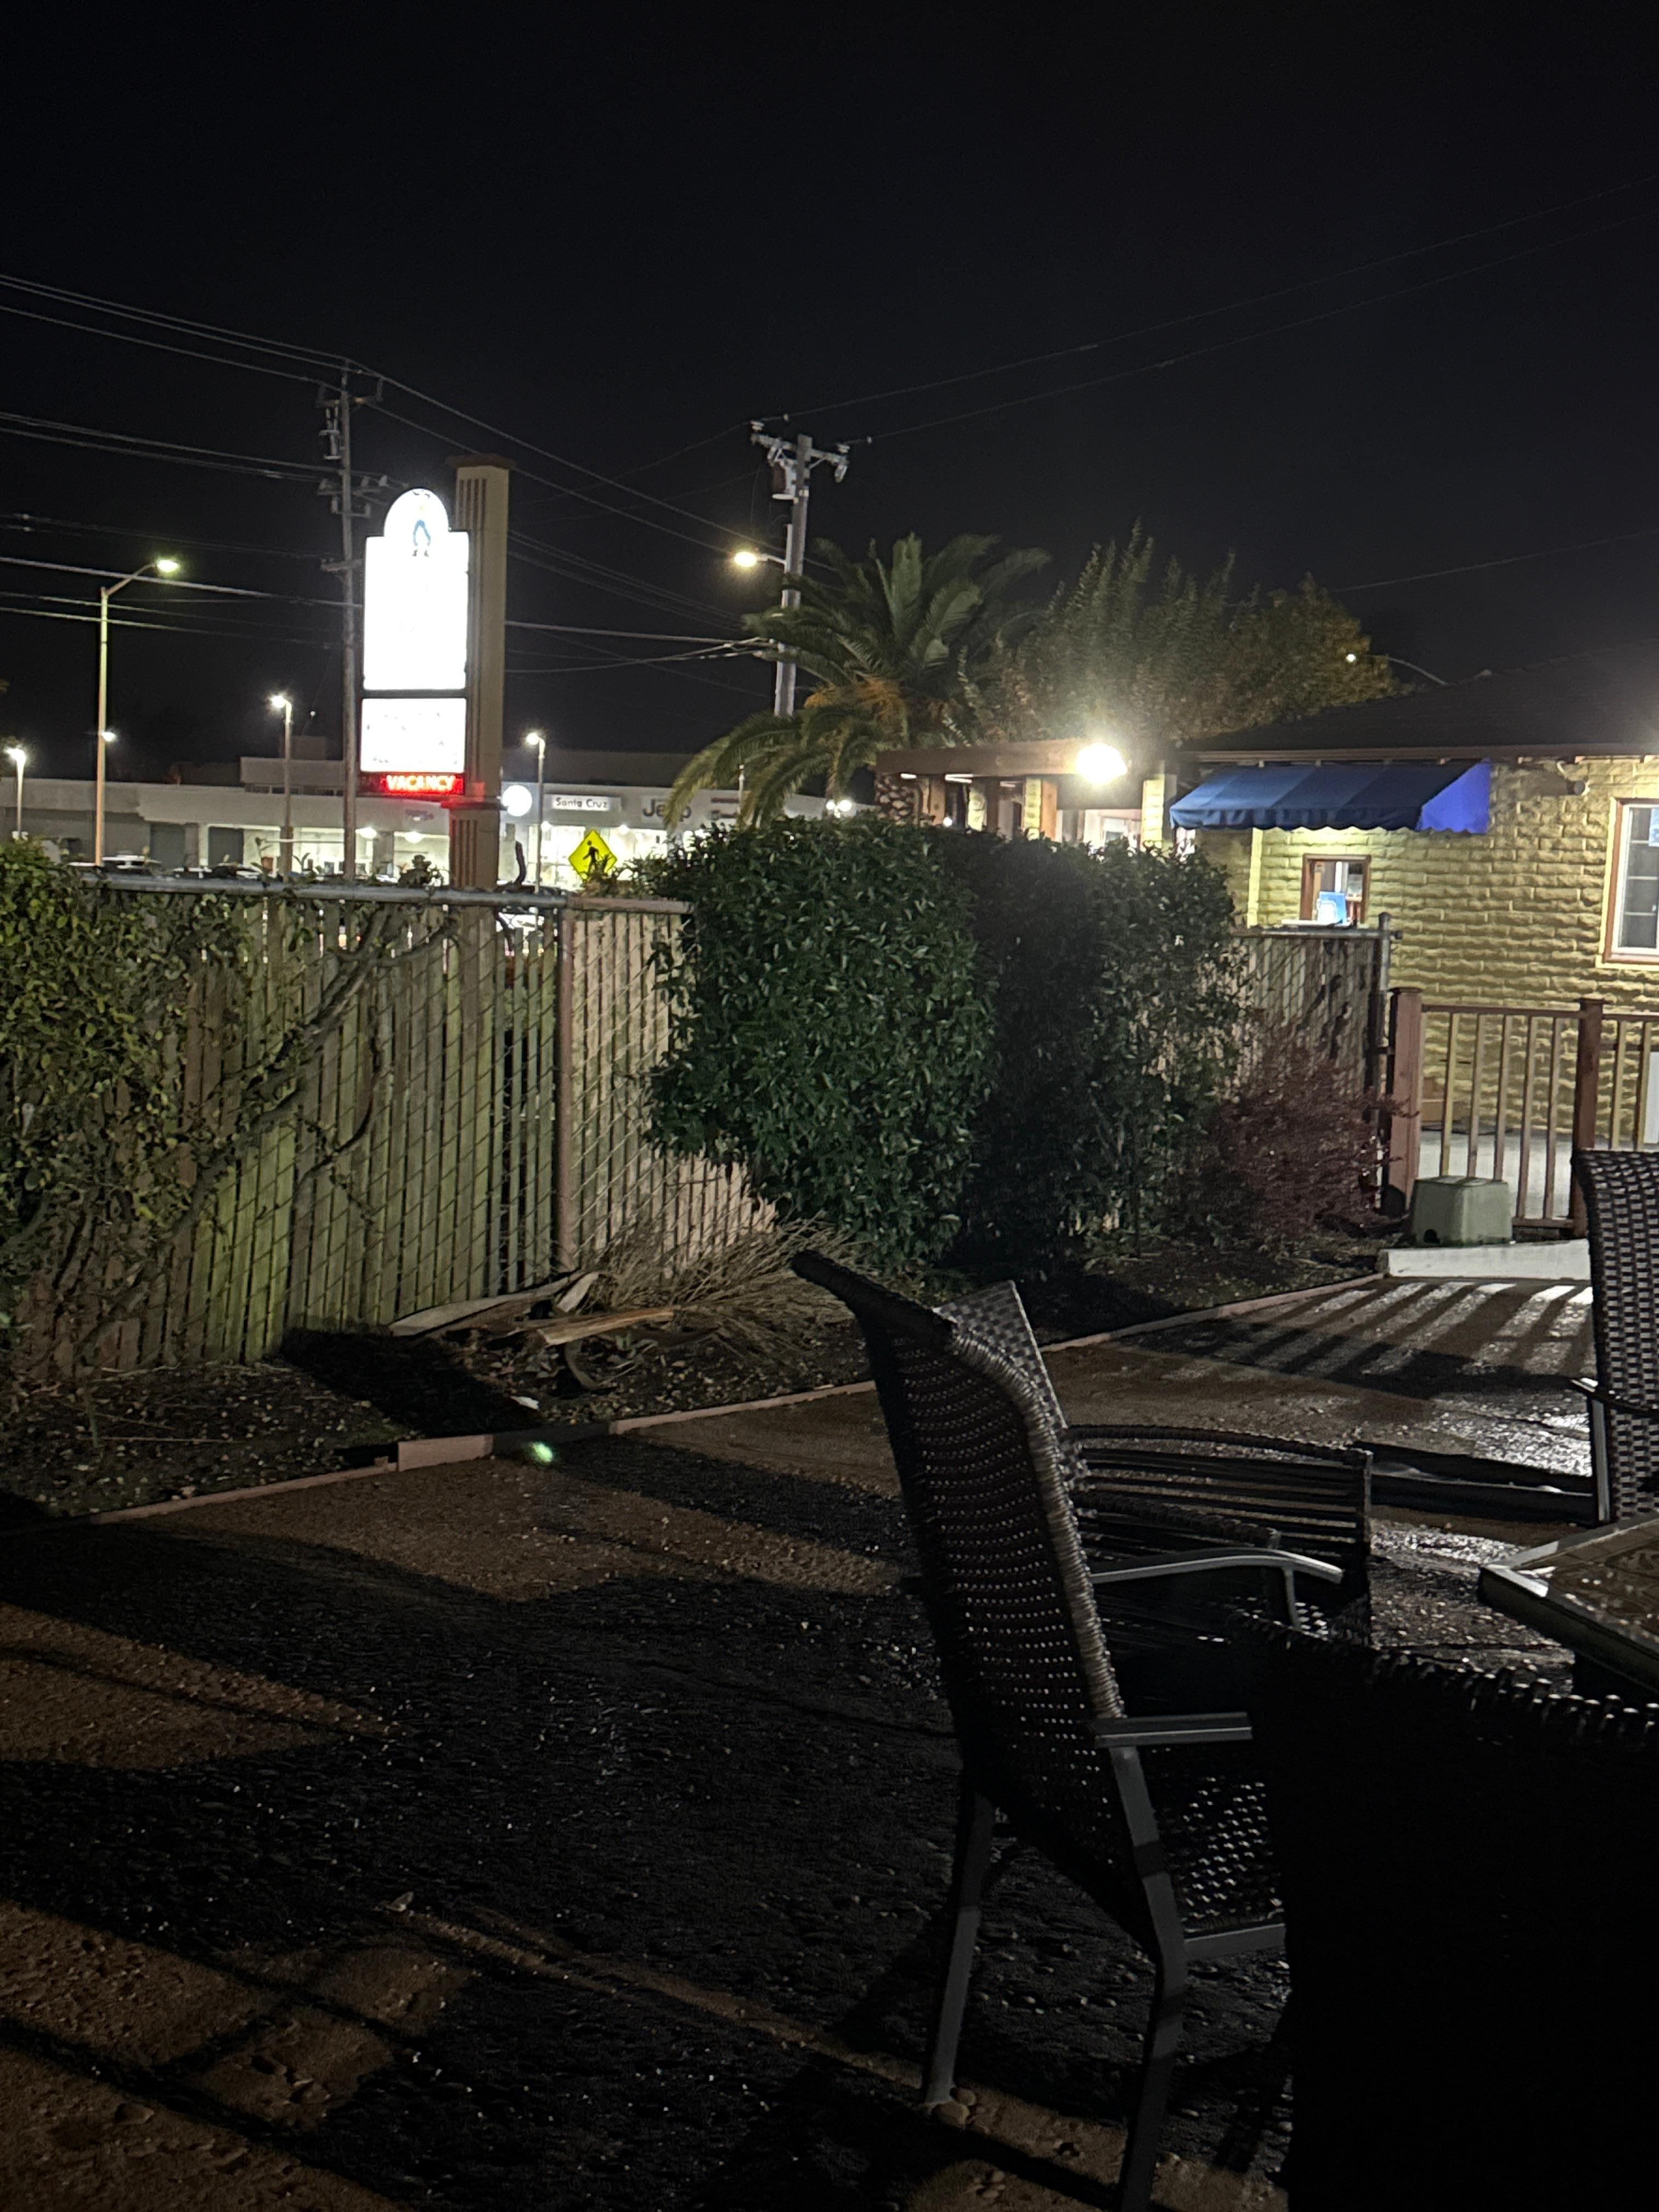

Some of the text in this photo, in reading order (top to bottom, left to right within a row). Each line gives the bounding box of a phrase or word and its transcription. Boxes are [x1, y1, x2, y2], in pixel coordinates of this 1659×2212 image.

[386, 775, 456, 791] VACANCY
[556, 797, 607, 808] Santa Cruz
[642, 799, 691, 822] Jep
